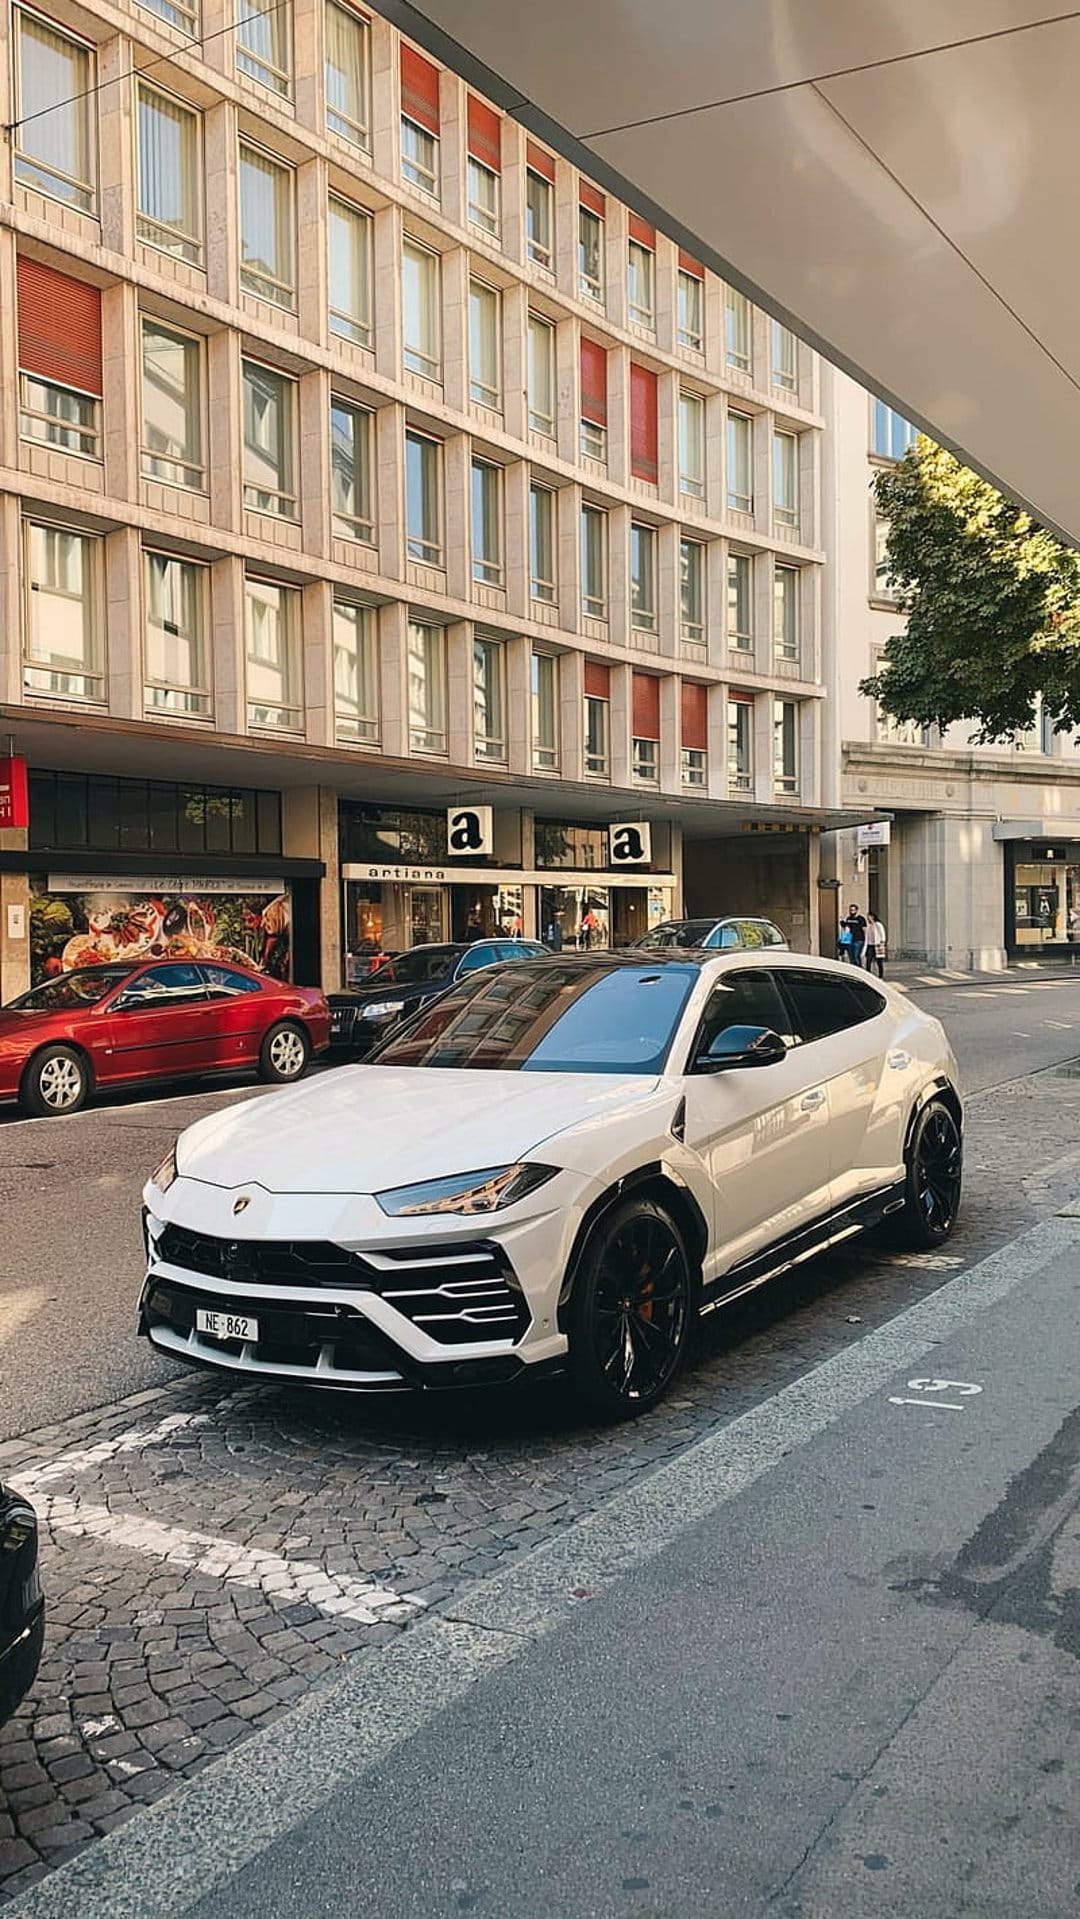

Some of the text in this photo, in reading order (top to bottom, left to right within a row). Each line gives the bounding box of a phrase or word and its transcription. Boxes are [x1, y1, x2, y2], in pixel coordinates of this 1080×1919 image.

[450, 812, 484, 850] a
[613, 827, 645, 860] a
[368, 867, 446, 881] artiana
[889, 1378, 983, 1411] 19
